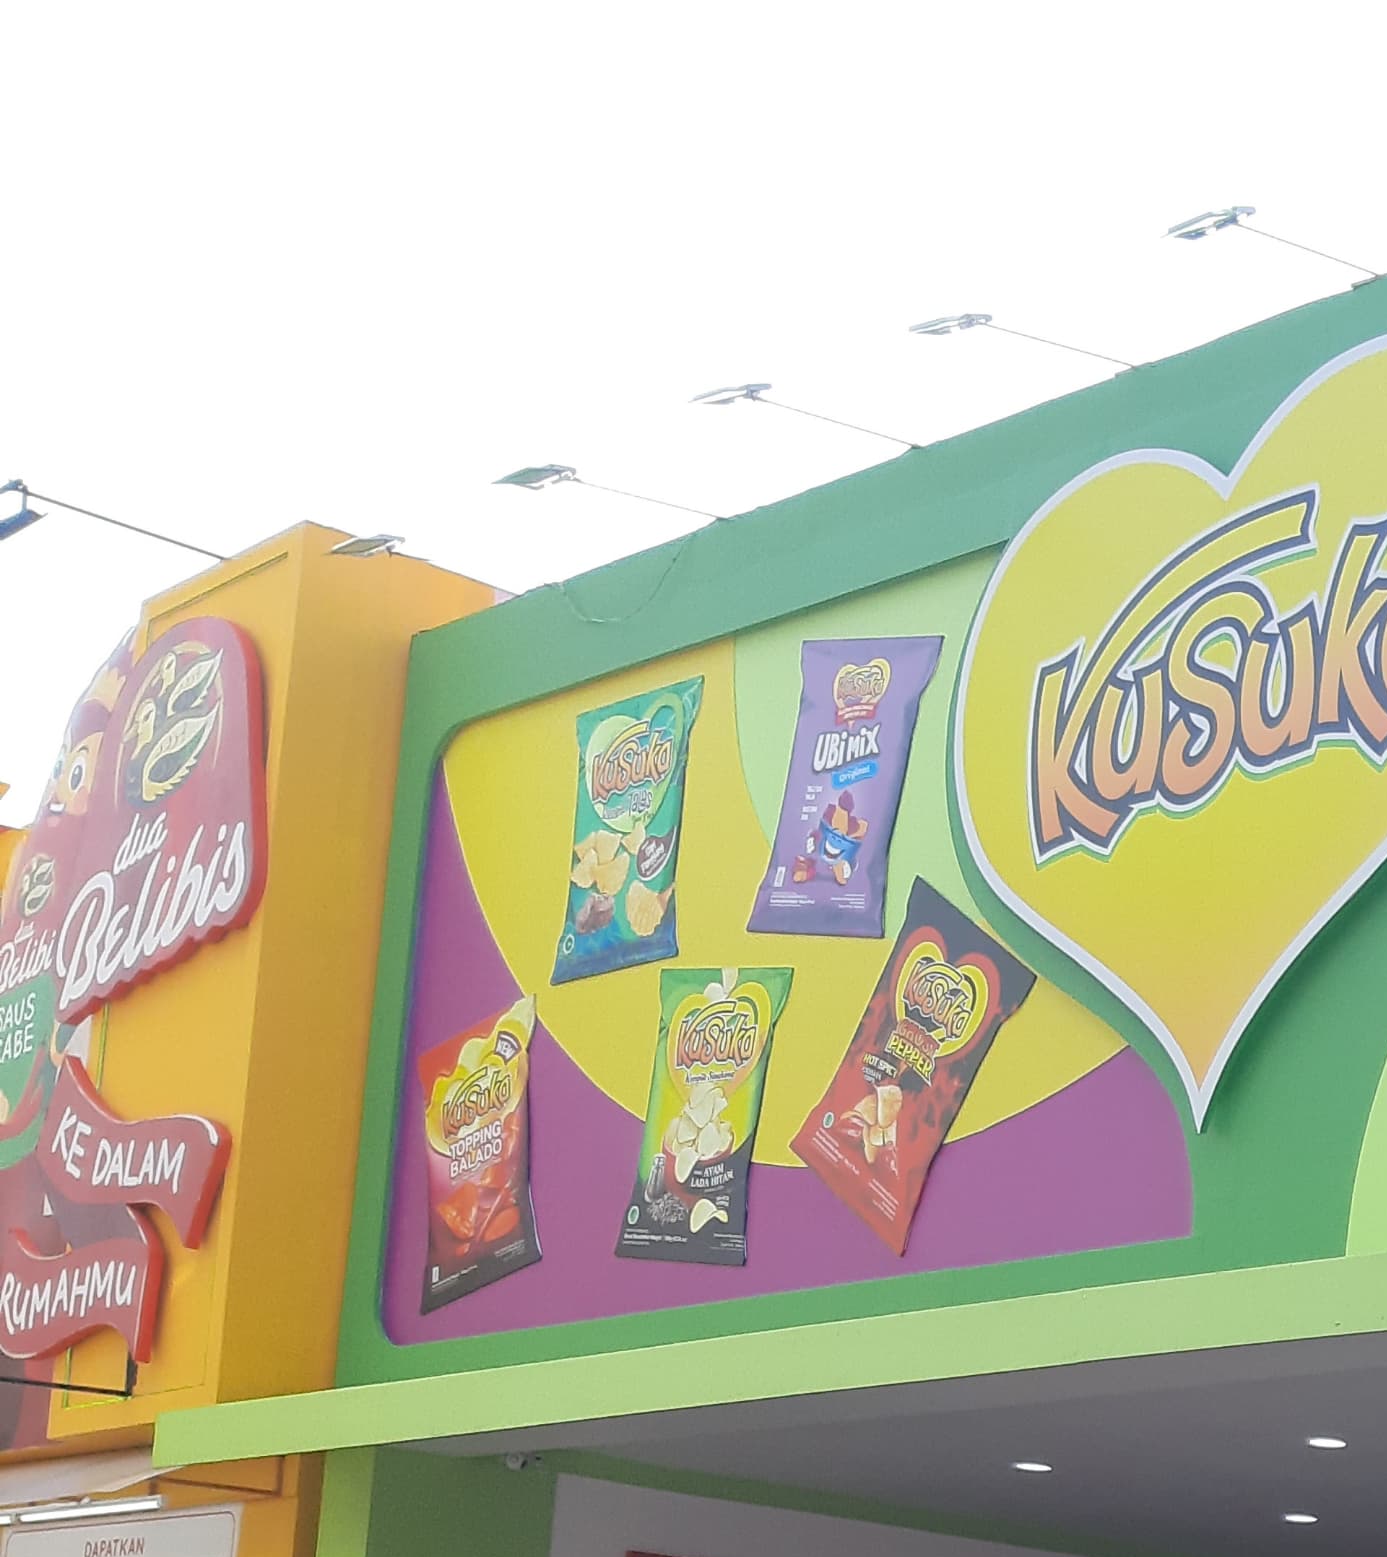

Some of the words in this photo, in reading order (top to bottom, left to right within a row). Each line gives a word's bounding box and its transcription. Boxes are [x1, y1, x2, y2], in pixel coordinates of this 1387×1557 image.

[113, 812, 168, 875] dua
[56, 821, 245, 1010] Belibis
[886, 1033, 935, 1082] PEPPER
[52, 1106, 92, 1178] KE
[92, 1138, 186, 1194] DALAM
[450, 1121, 502, 1160] TOPPING
[450, 1138, 503, 1178] BALADO
[0, 1260, 136, 1335] RUMAHMU
